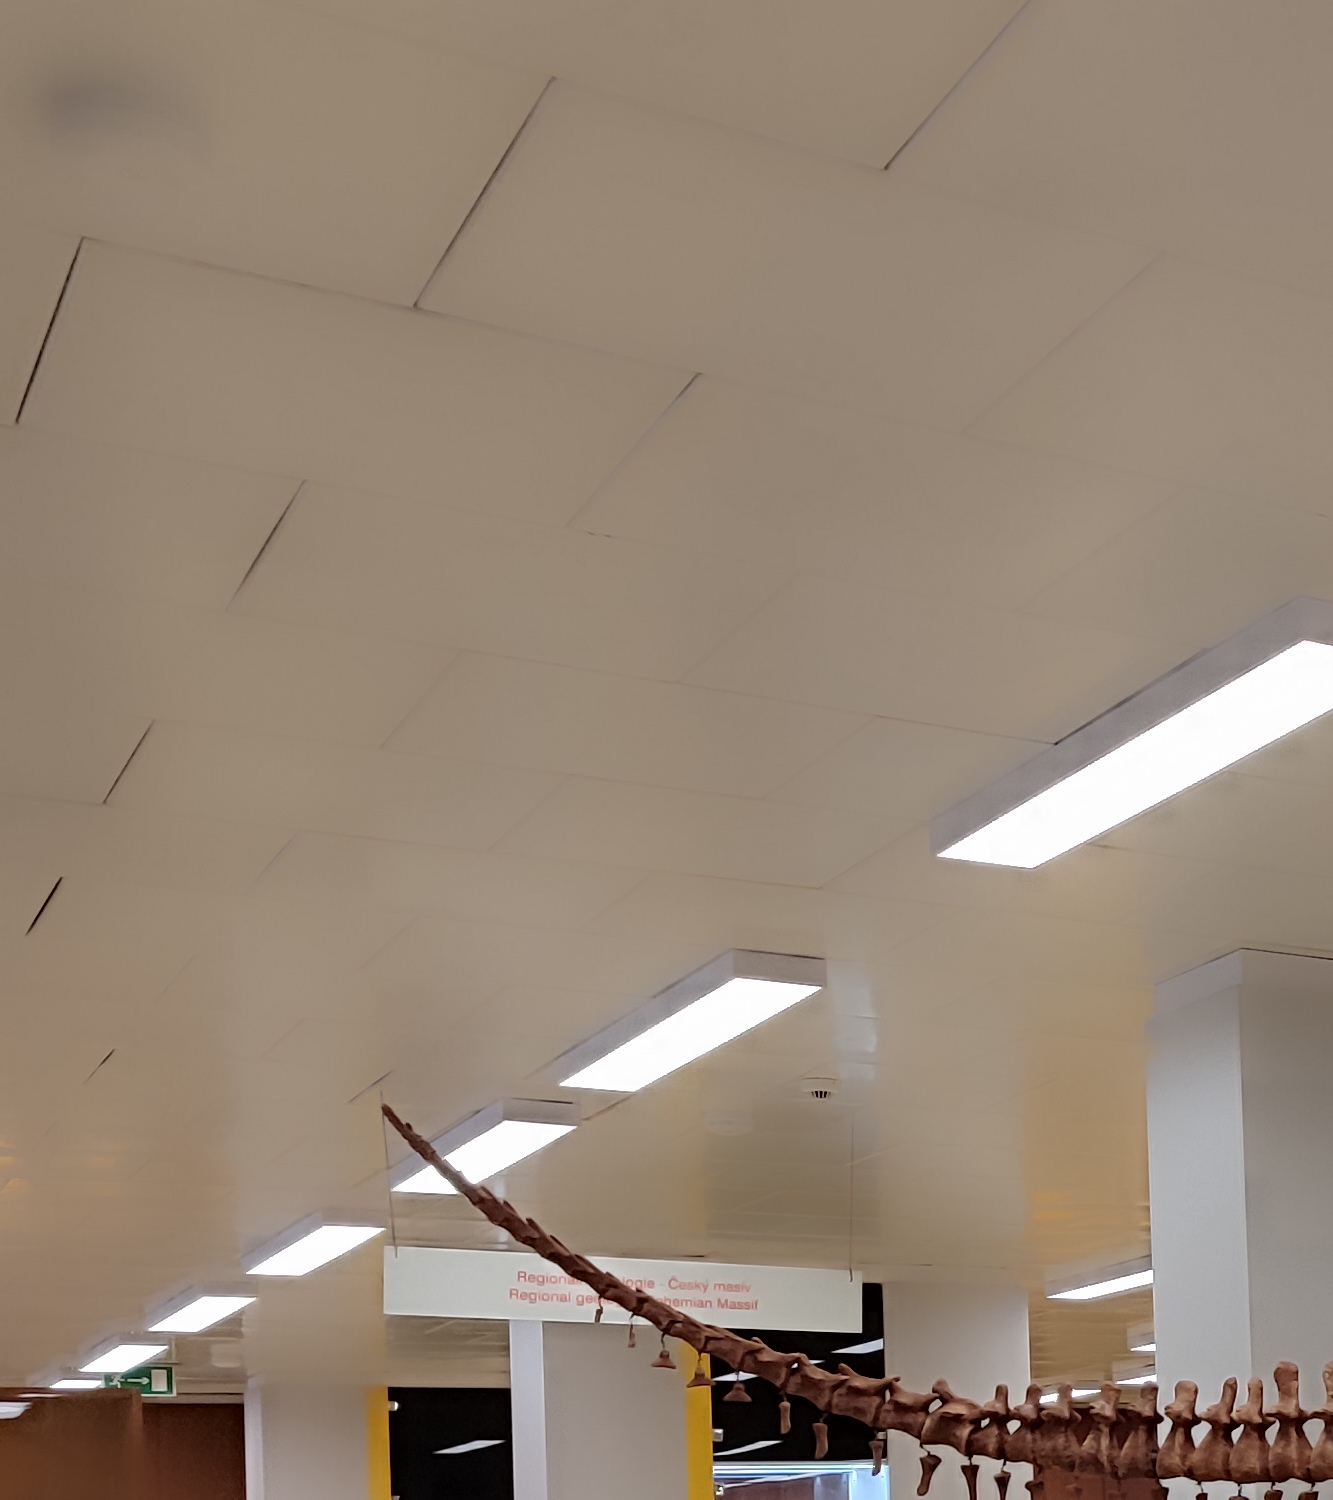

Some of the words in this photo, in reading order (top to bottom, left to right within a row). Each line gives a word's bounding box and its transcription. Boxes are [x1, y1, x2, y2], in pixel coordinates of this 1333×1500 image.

[667, 1275, 709, 1293] Český
[713, 1281, 751, 1293] masiv
[509, 1288, 571, 1304] Regional
[716, 1298, 758, 1310] Massif
